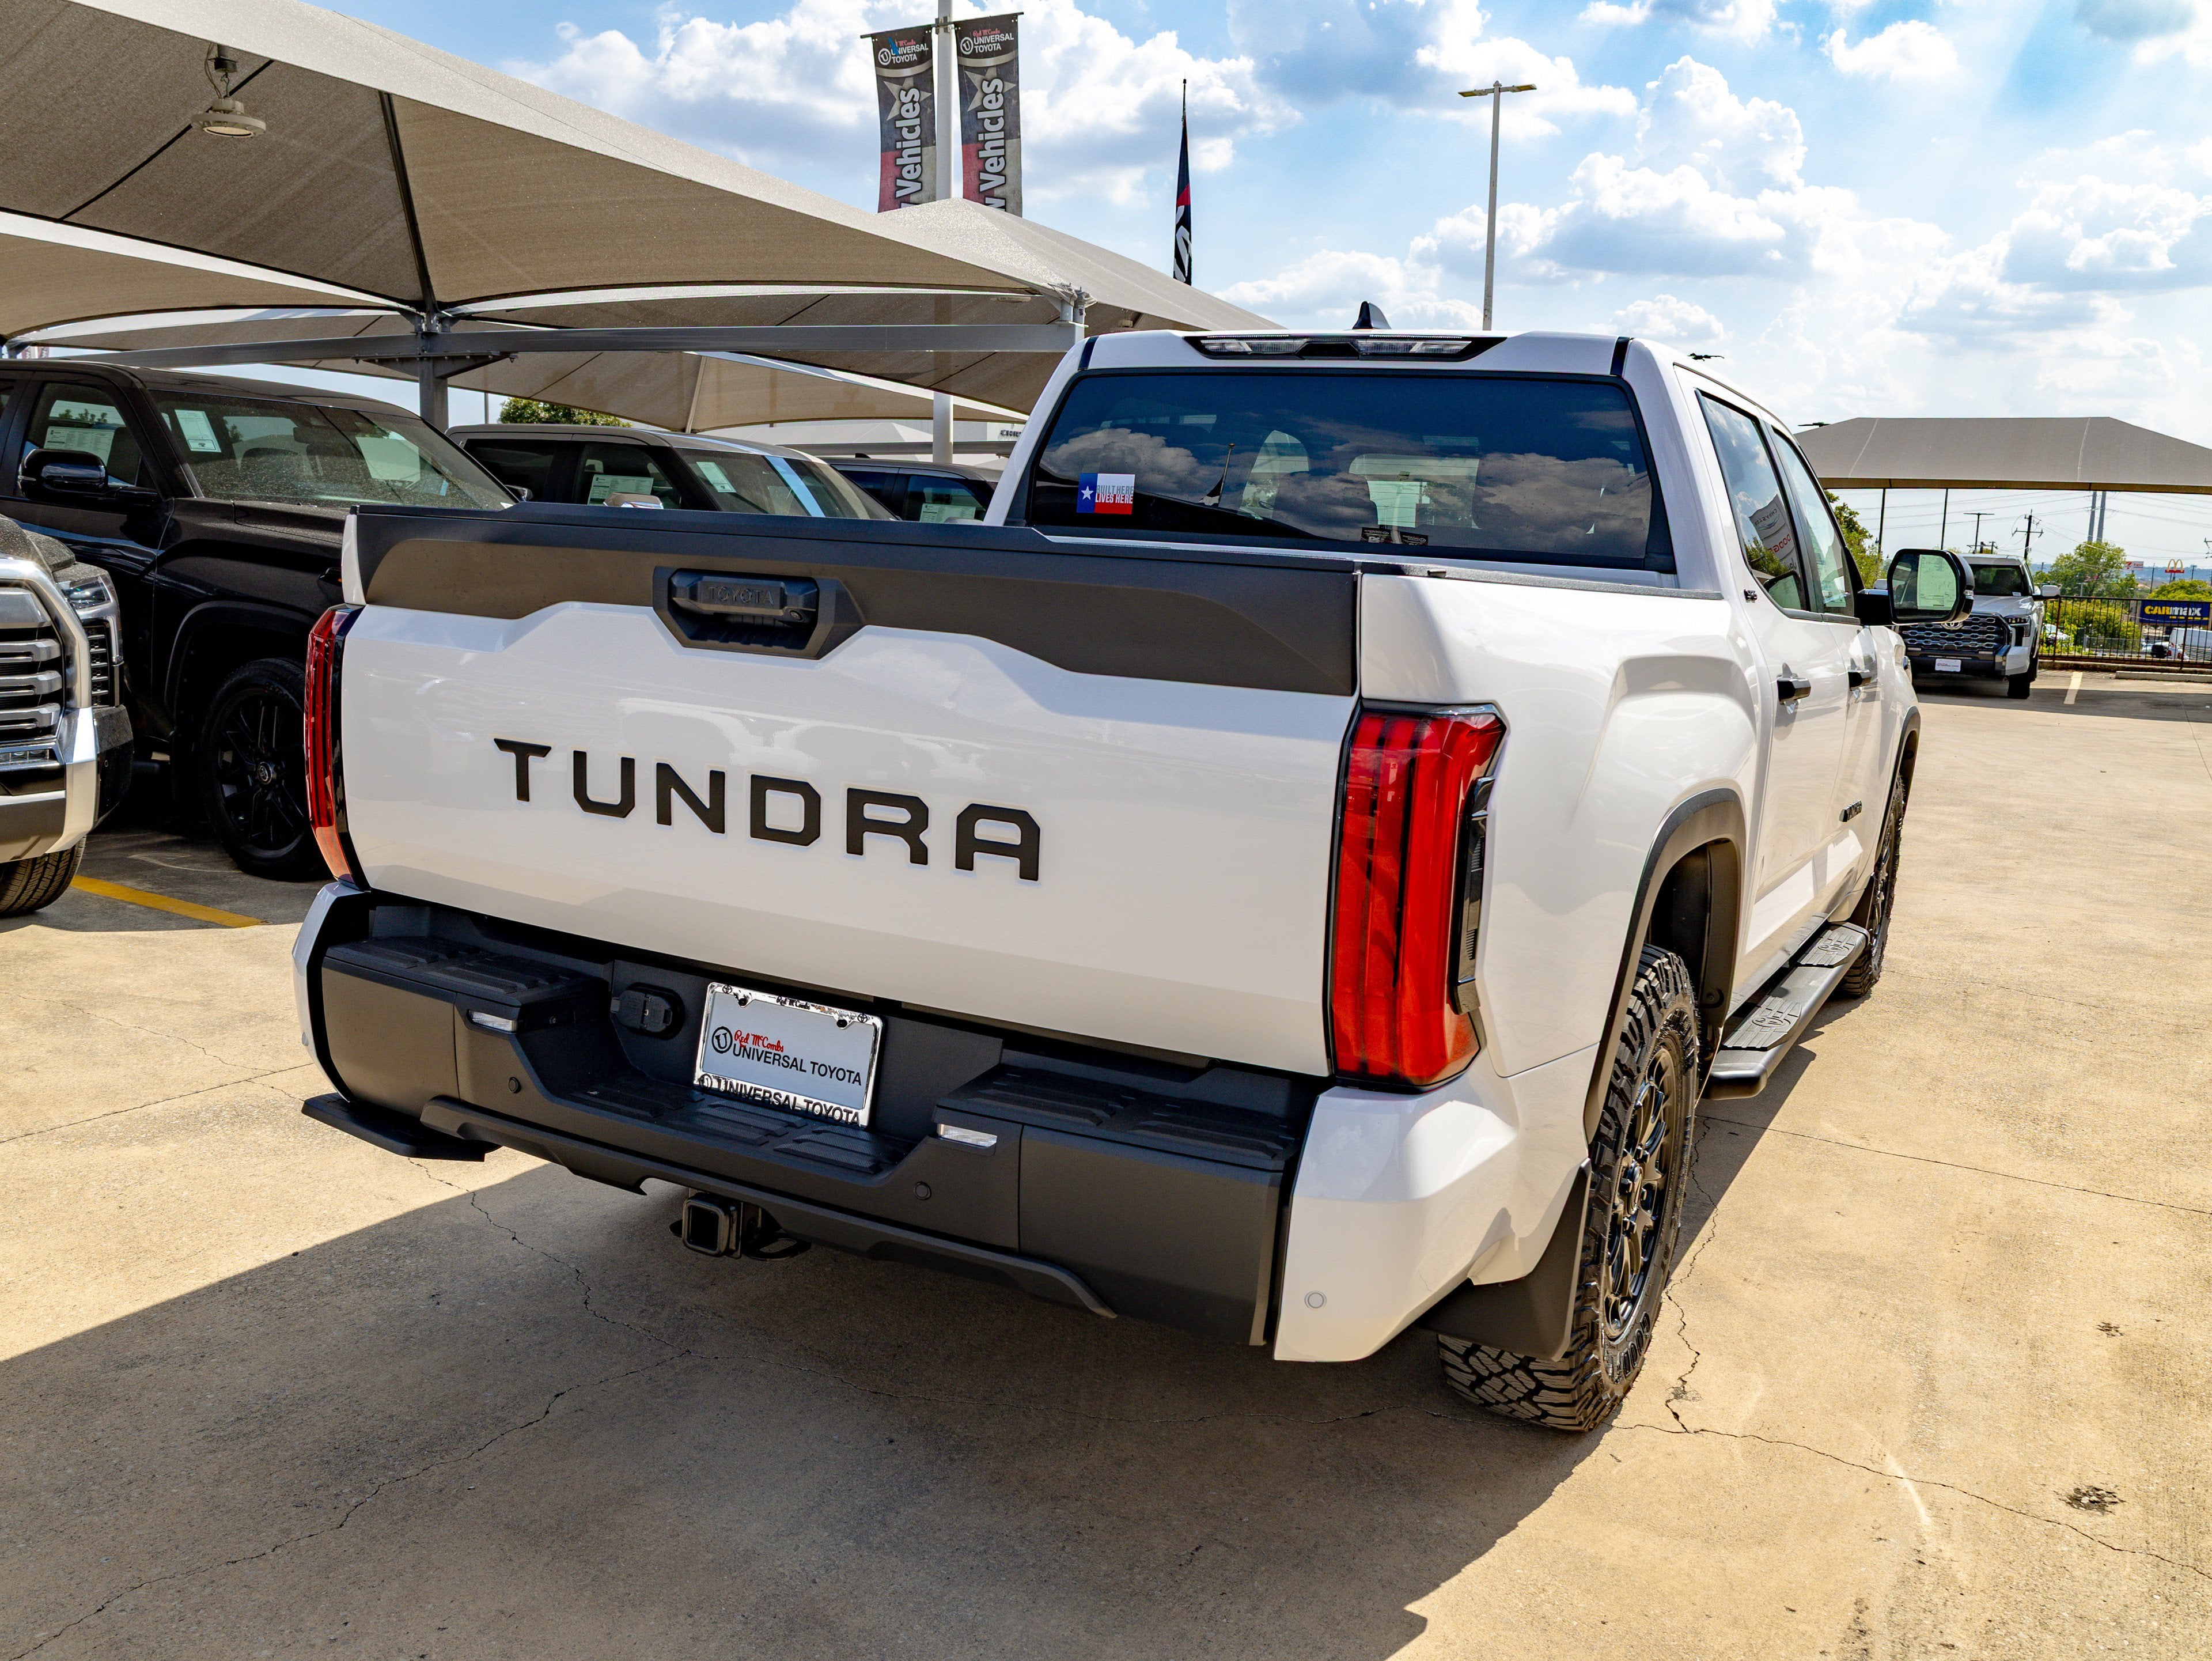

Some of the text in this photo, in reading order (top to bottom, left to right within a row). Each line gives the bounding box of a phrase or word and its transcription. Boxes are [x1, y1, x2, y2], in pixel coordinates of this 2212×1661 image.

[974, 32, 1014, 45] UNIVERSAL
[974, 43, 1002, 53] TOYOTA
[892, 53, 917, 64] TOYOTA
[895, 88, 922, 198] Vehicles
[977, 78, 1006, 192] Vehicles
[1000, 429, 1021, 437] CHR
[1095, 493, 1134, 504] LIVES HERE
[1096, 485, 1134, 495] BUILT HERE
[706, 585, 774, 606] TOYOTA
[493, 737, 1040, 881] TUNDRA
[734, 1030, 784, 1053] Red McCombs
[733, 1043, 862, 1086] UNIVERSAL TOYOTA
[718, 1078, 801, 1111] UNIVERSAL
[804, 1099, 861, 1127] TOYOTA
